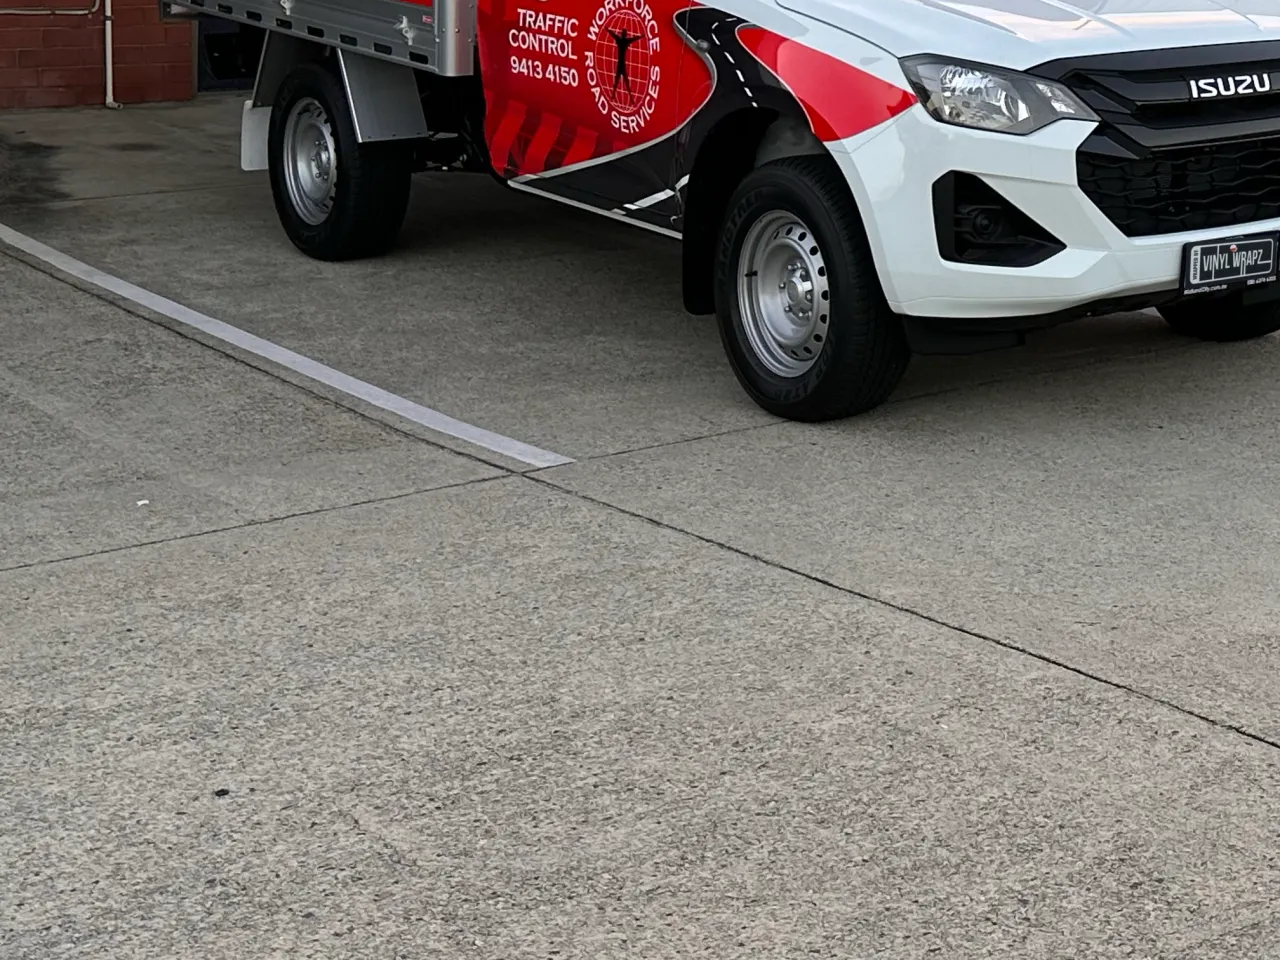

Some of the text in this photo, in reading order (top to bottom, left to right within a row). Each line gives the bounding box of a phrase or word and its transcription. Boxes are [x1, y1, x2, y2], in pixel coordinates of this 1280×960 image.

[517, 8, 579, 37] TRAFFIC
[508, 29, 578, 60] CONTROL
[510, 56, 579, 87] 9413 4150
[1189, 73, 1271, 98] ISUZU
[584, 51, 661, 133] ROAD SERVICES
[1203, 249, 1264, 272] VINYL WRAPZ
